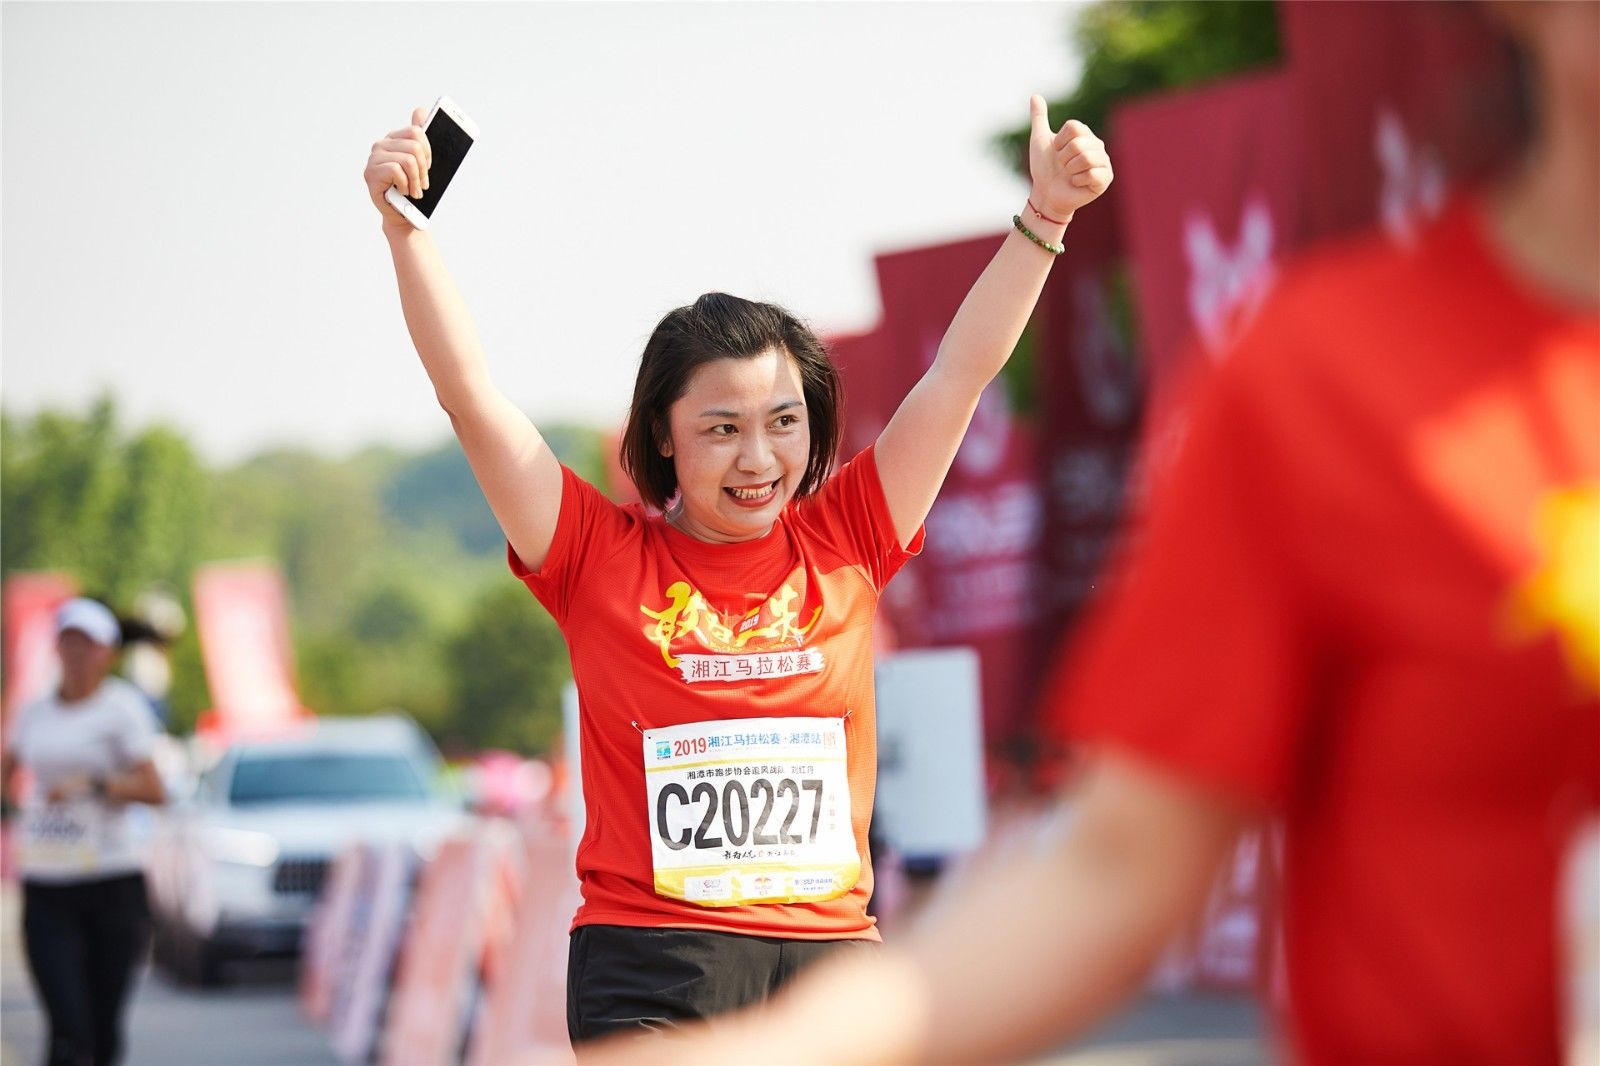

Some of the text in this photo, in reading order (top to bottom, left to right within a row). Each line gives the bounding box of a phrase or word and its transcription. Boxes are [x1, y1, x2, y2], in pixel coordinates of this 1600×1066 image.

[739, 614, 760, 632] 2019
[691, 653, 812, 678] 湘江马拉松赛
[656, 778, 823, 851] C20227
